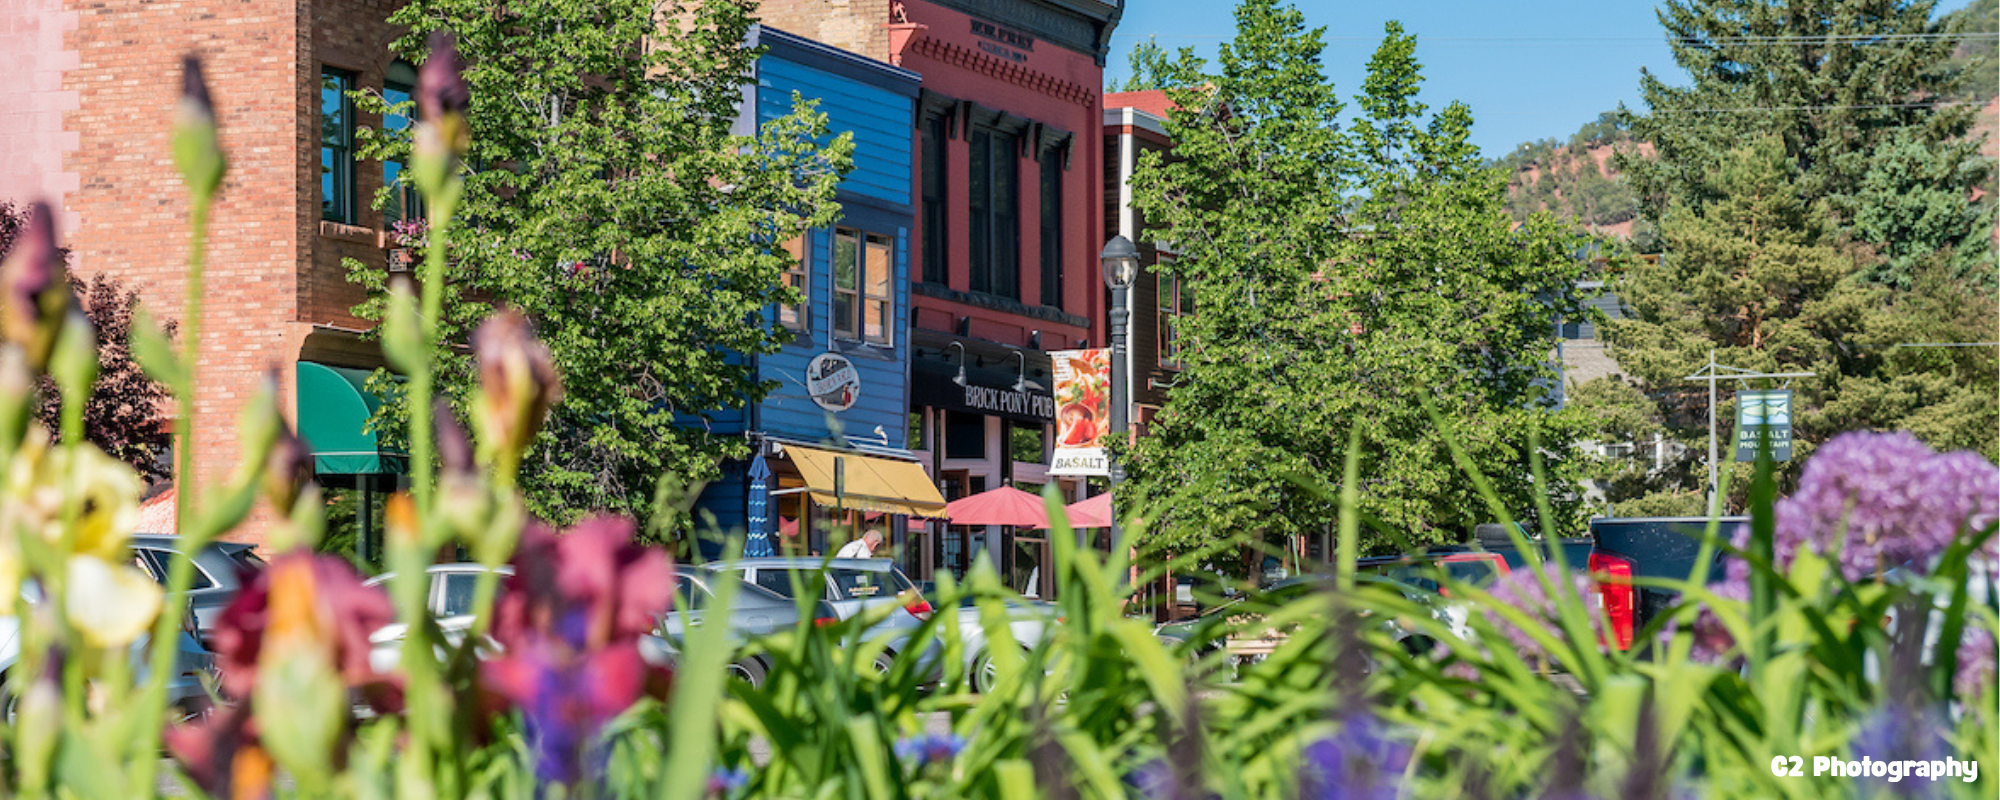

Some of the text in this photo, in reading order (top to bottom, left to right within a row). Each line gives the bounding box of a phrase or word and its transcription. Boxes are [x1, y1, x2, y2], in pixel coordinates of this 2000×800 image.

[965, 385, 1054, 418] BRICK PONY PUB
[1739, 441, 1789, 449] MOUTAIN
[1055, 457, 1104, 469] BASALT
